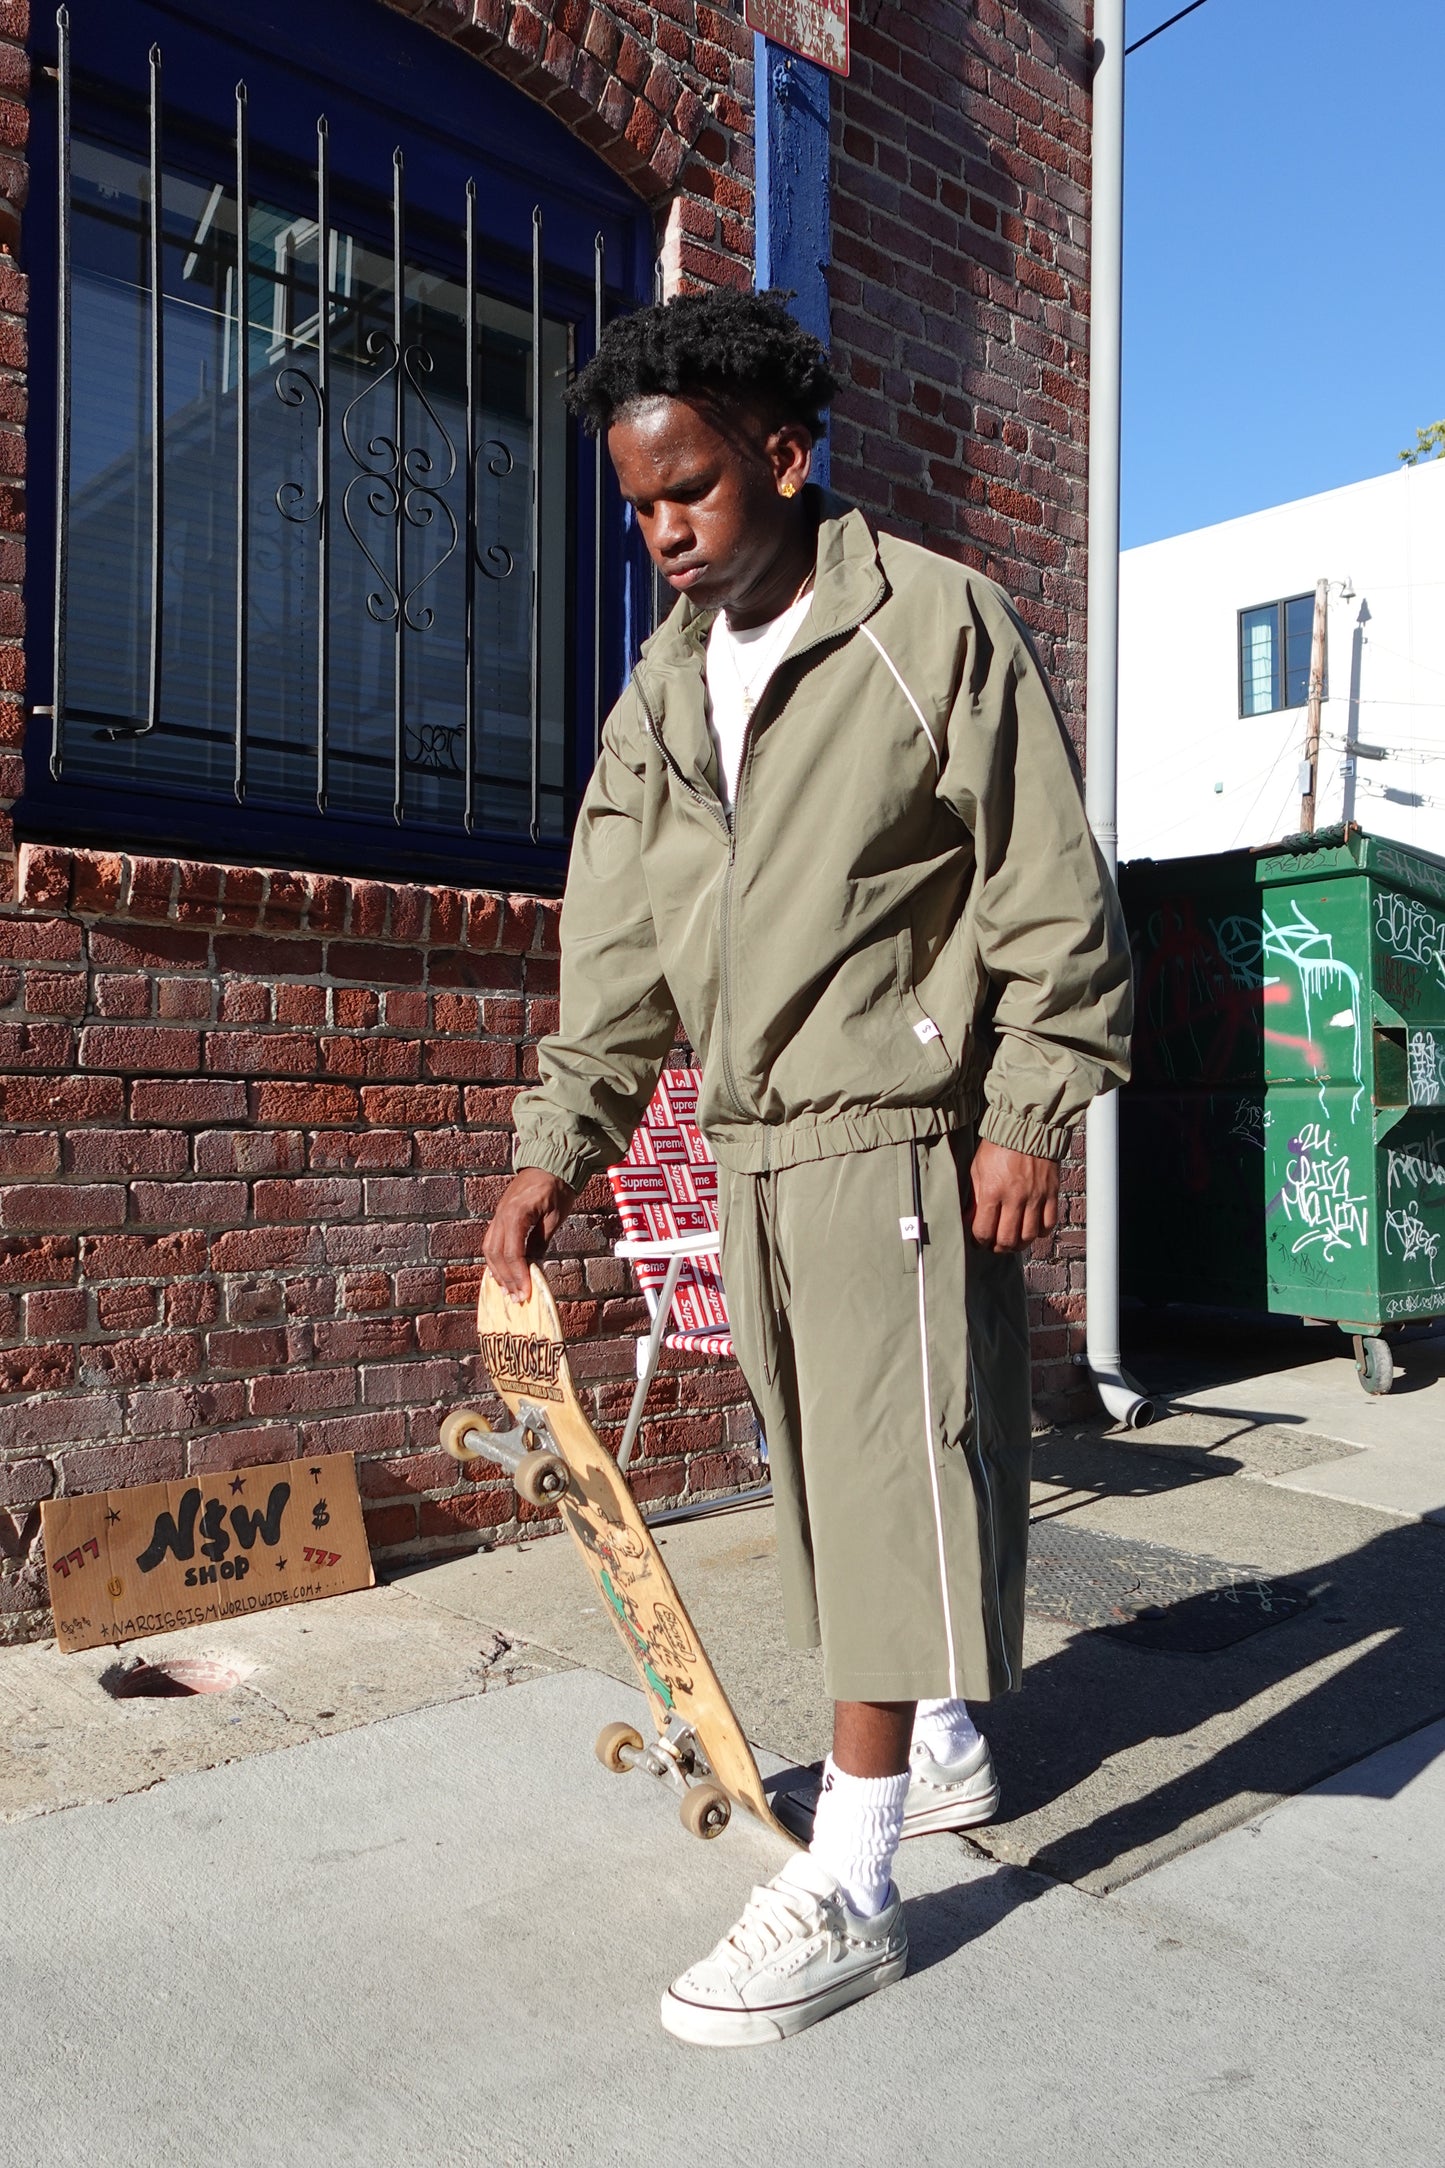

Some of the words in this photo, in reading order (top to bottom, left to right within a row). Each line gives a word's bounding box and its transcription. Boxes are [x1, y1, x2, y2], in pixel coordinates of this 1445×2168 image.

[672, 1100, 697, 1113] upre
[620, 1175, 664, 1191] Supreme
[671, 1164, 688, 1202] Supre
[708, 1284, 725, 1323] Supre
[52, 1537, 100, 1579] 777
[184, 1554, 250, 1587] SHOP
[303, 1546, 342, 1567] 777
